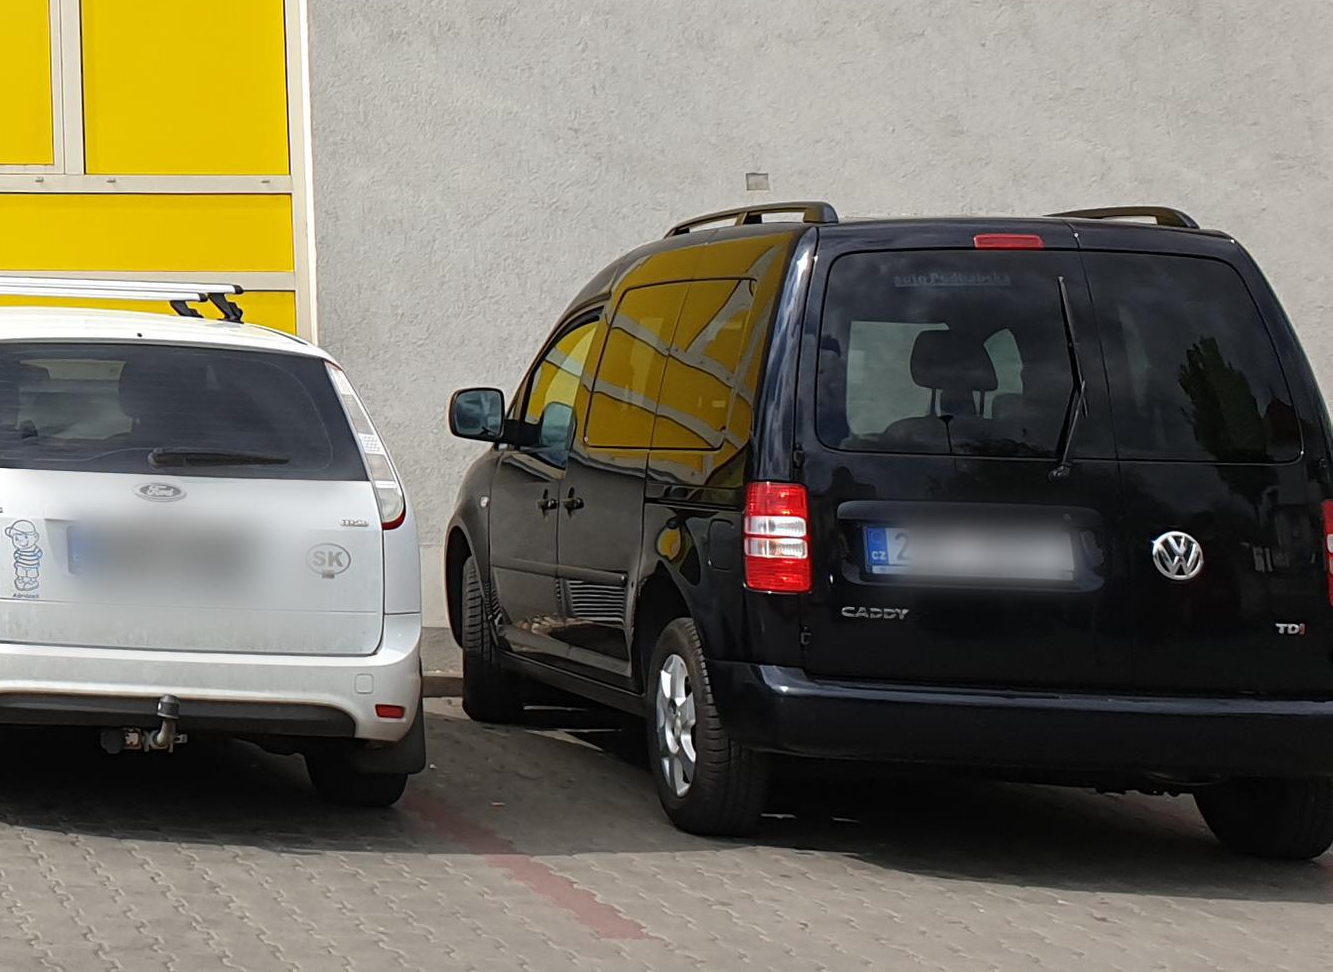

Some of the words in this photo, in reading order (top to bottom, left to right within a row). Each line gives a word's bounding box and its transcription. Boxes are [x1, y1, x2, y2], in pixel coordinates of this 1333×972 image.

[312, 550, 343, 568] SK
[871, 550, 887, 561] CZ
[841, 606, 910, 620] CADDY
